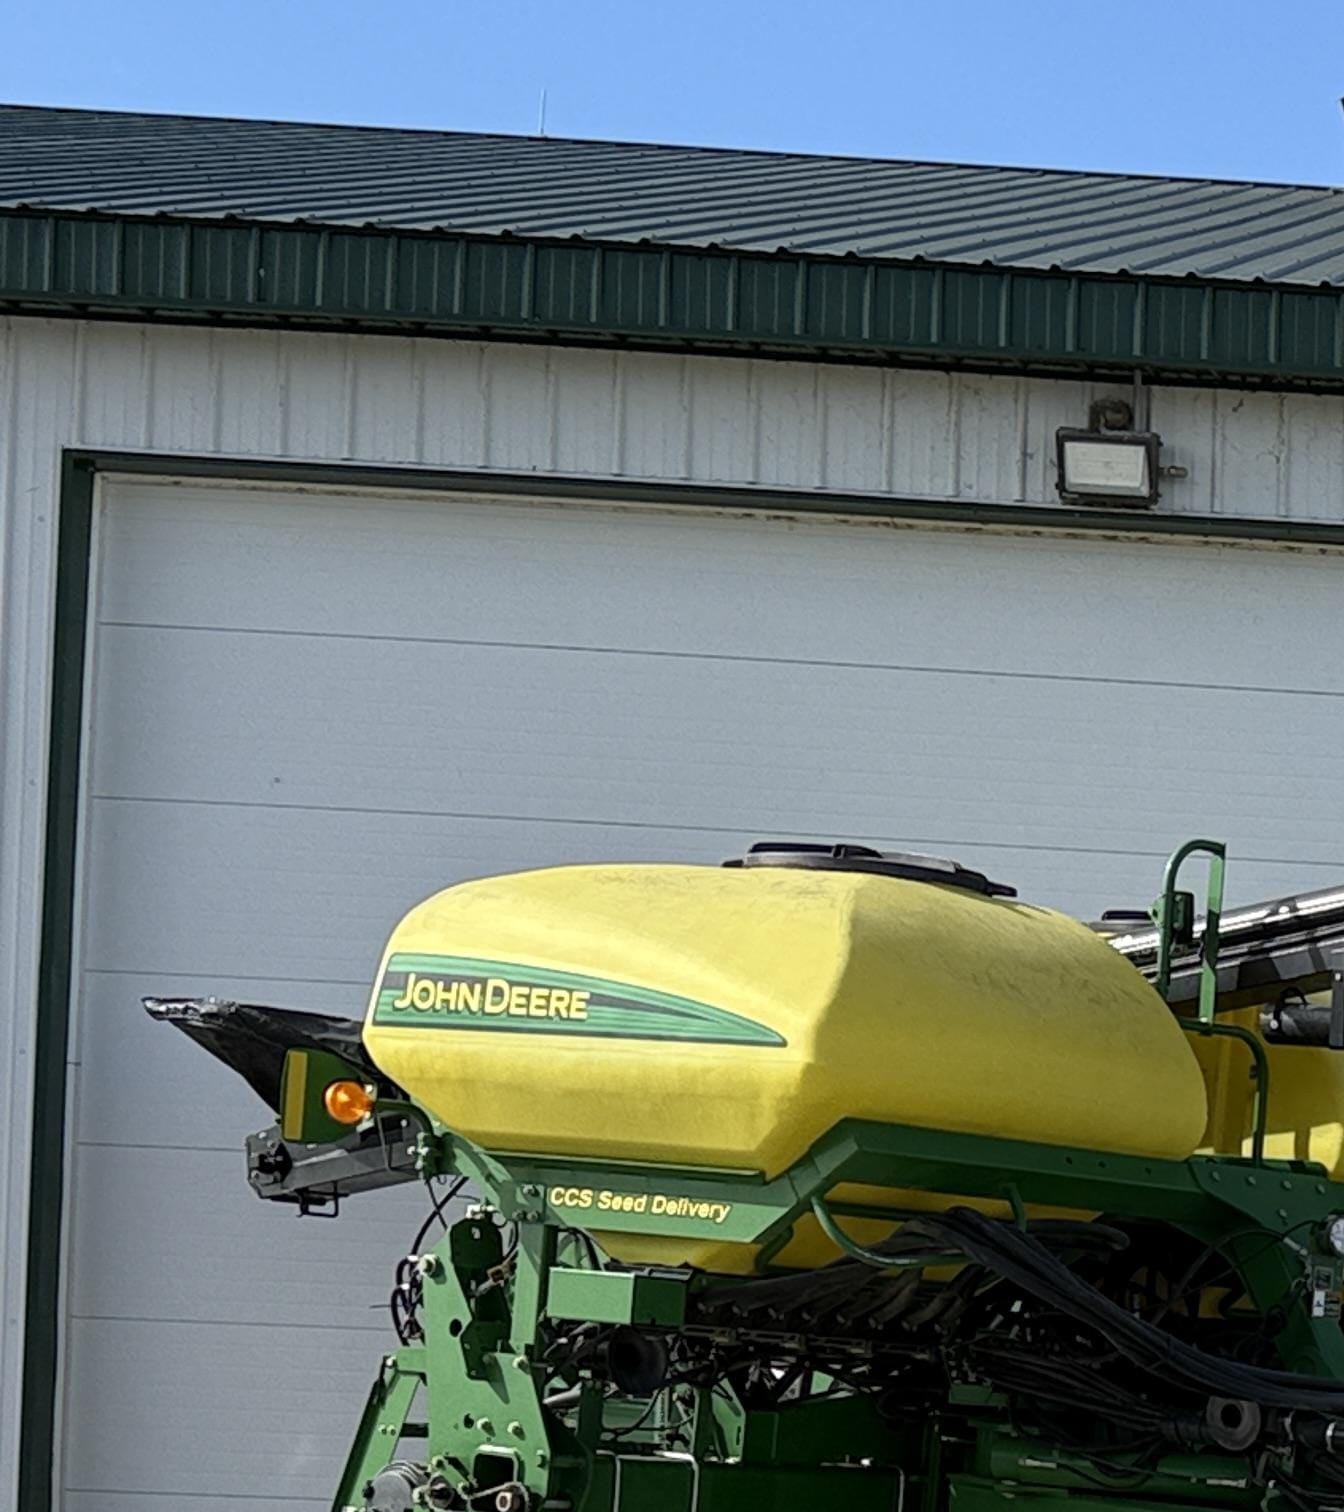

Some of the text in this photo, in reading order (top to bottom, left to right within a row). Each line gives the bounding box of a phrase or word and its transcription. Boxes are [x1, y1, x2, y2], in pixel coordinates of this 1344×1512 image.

[394, 973, 591, 1020] JOHN DEERE
[550, 1187, 731, 1224] CCS Seed Delivery
